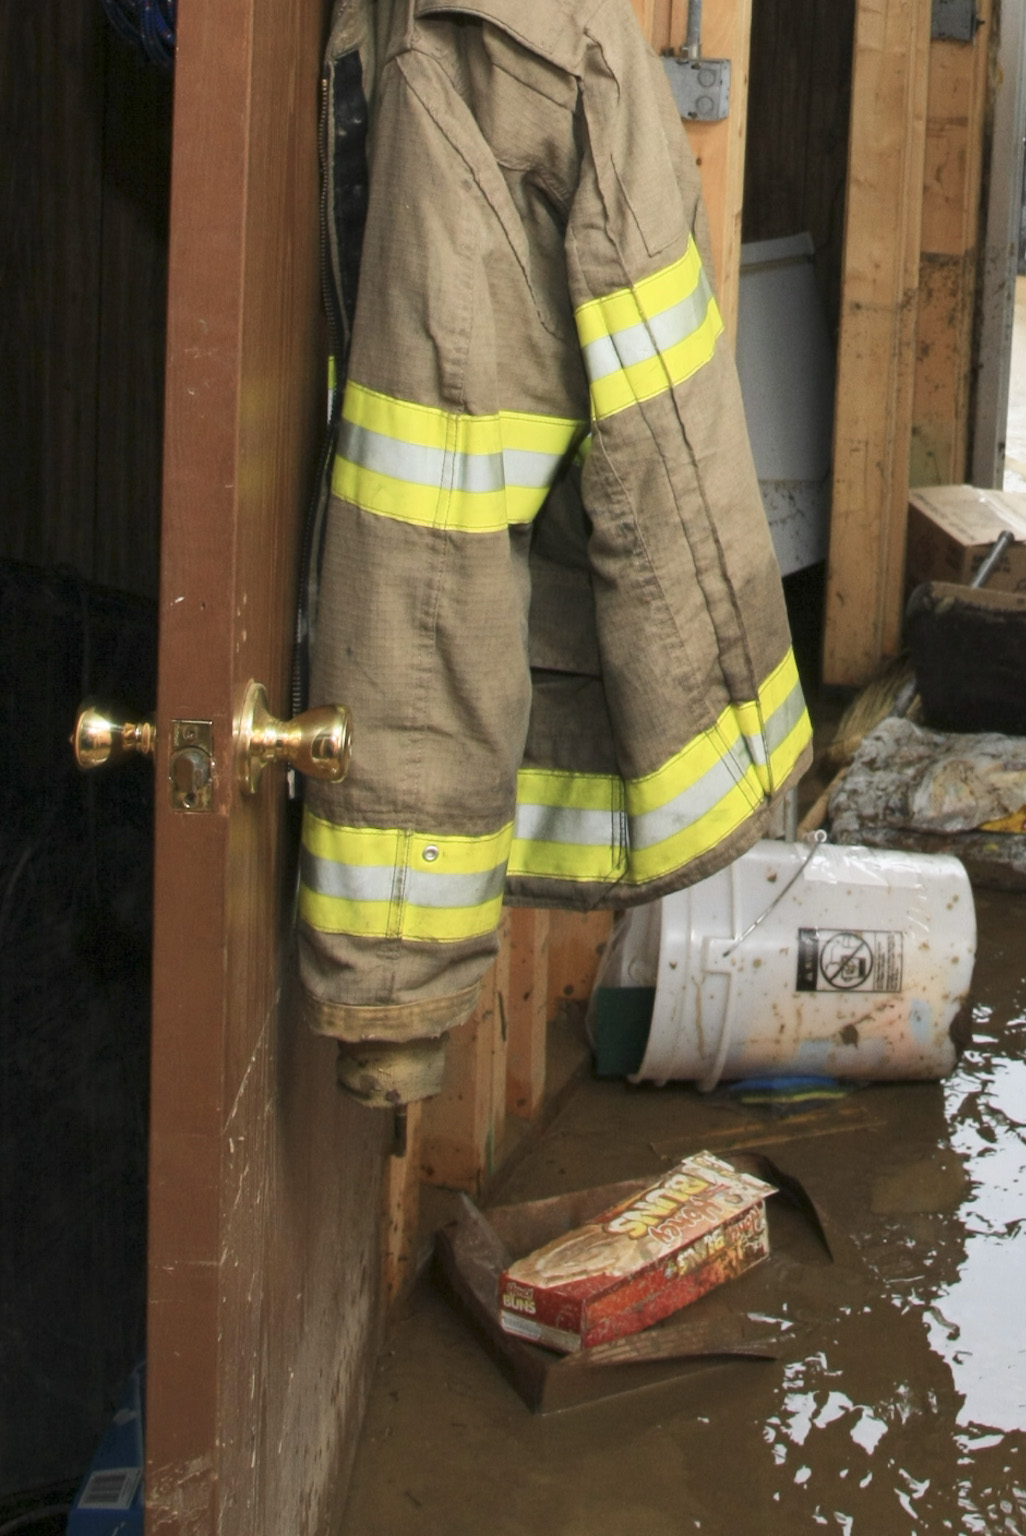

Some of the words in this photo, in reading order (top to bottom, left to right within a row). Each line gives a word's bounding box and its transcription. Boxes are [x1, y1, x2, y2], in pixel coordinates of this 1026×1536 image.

[604, 1173, 711, 1240] BUNS
[648, 1195, 726, 1245] Honey
[503, 1293, 537, 1315] BUNS
